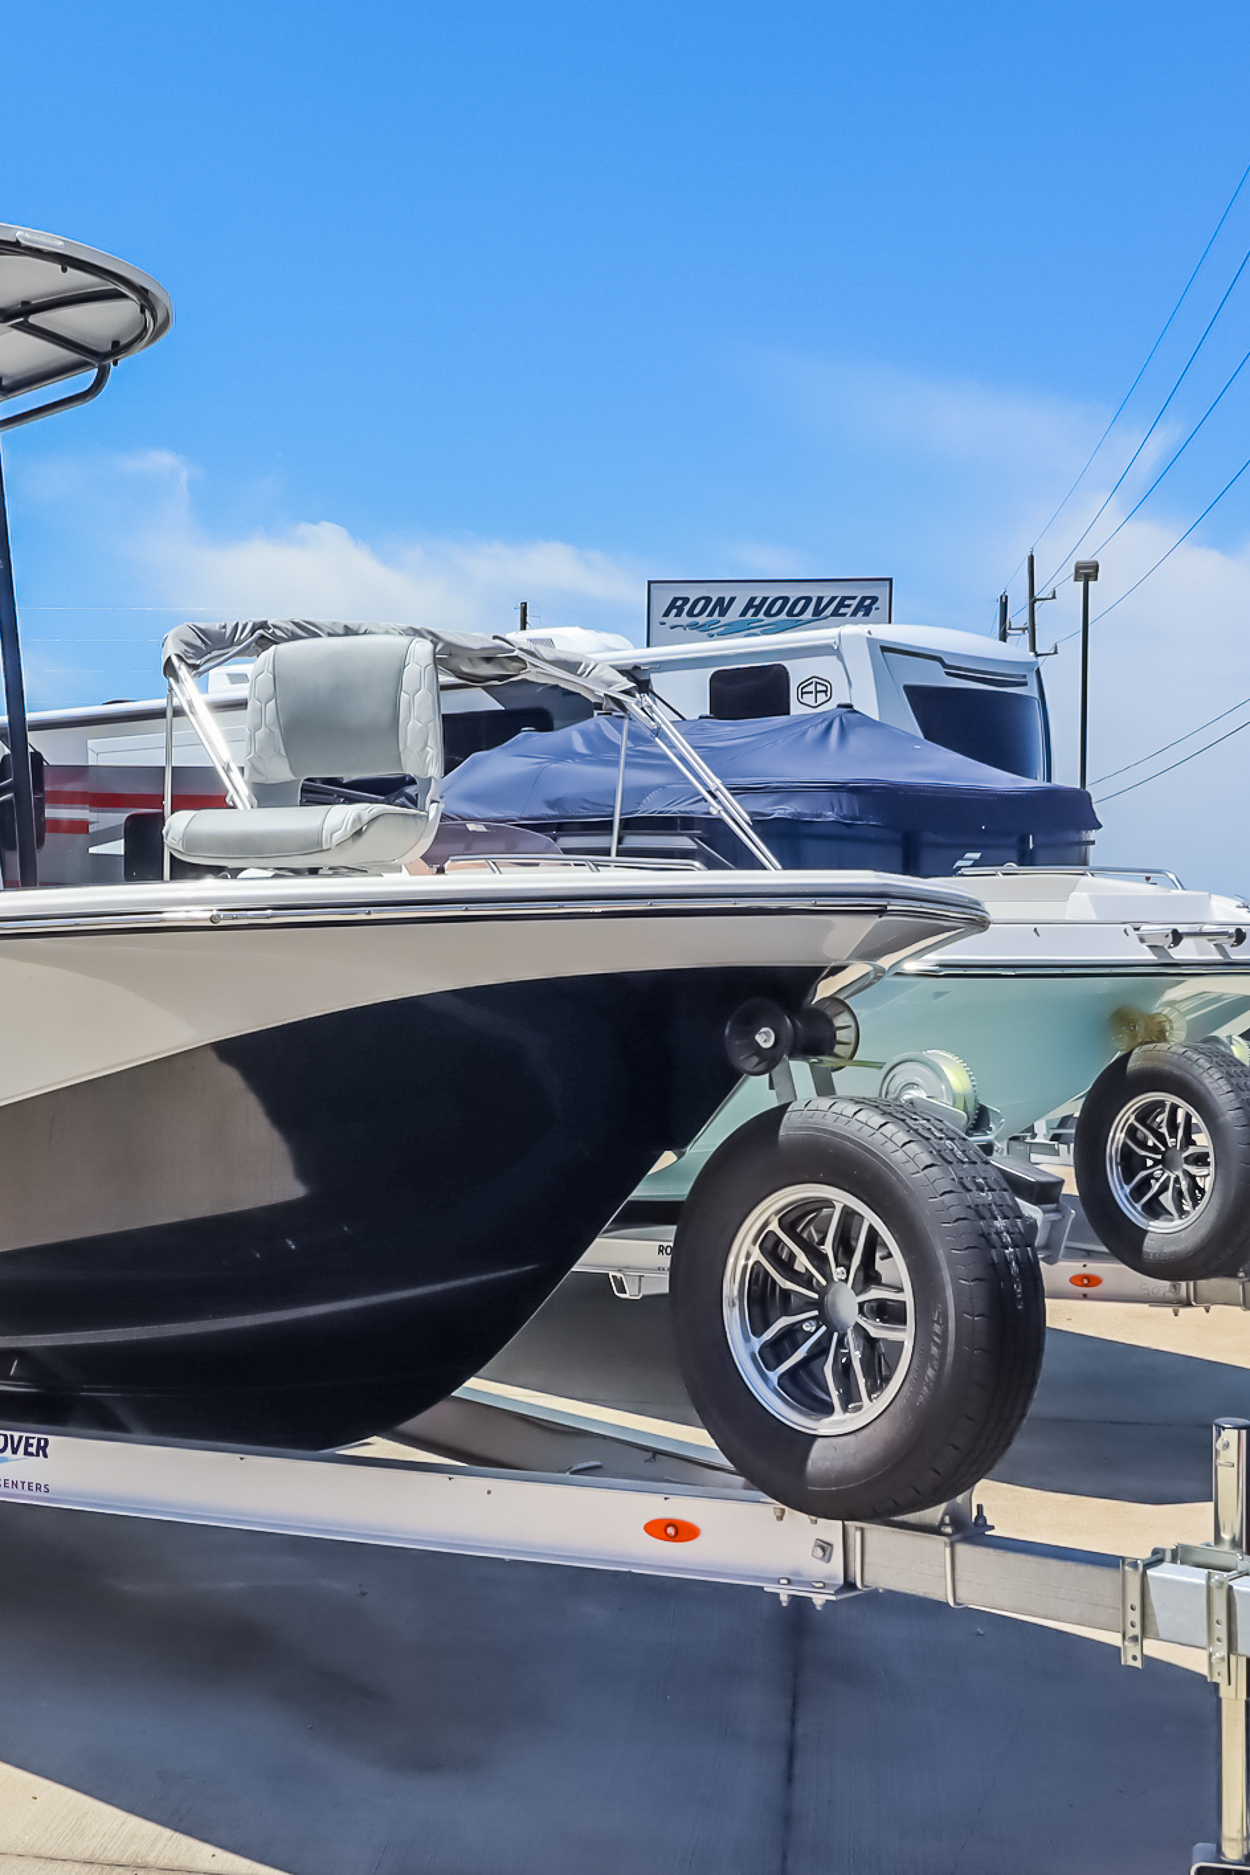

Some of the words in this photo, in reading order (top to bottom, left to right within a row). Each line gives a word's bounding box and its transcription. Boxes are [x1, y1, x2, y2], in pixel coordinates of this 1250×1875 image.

[661, 595, 737, 618] RON
[739, 595, 879, 618] HOOVER
[658, 1244, 673, 1256] RO
